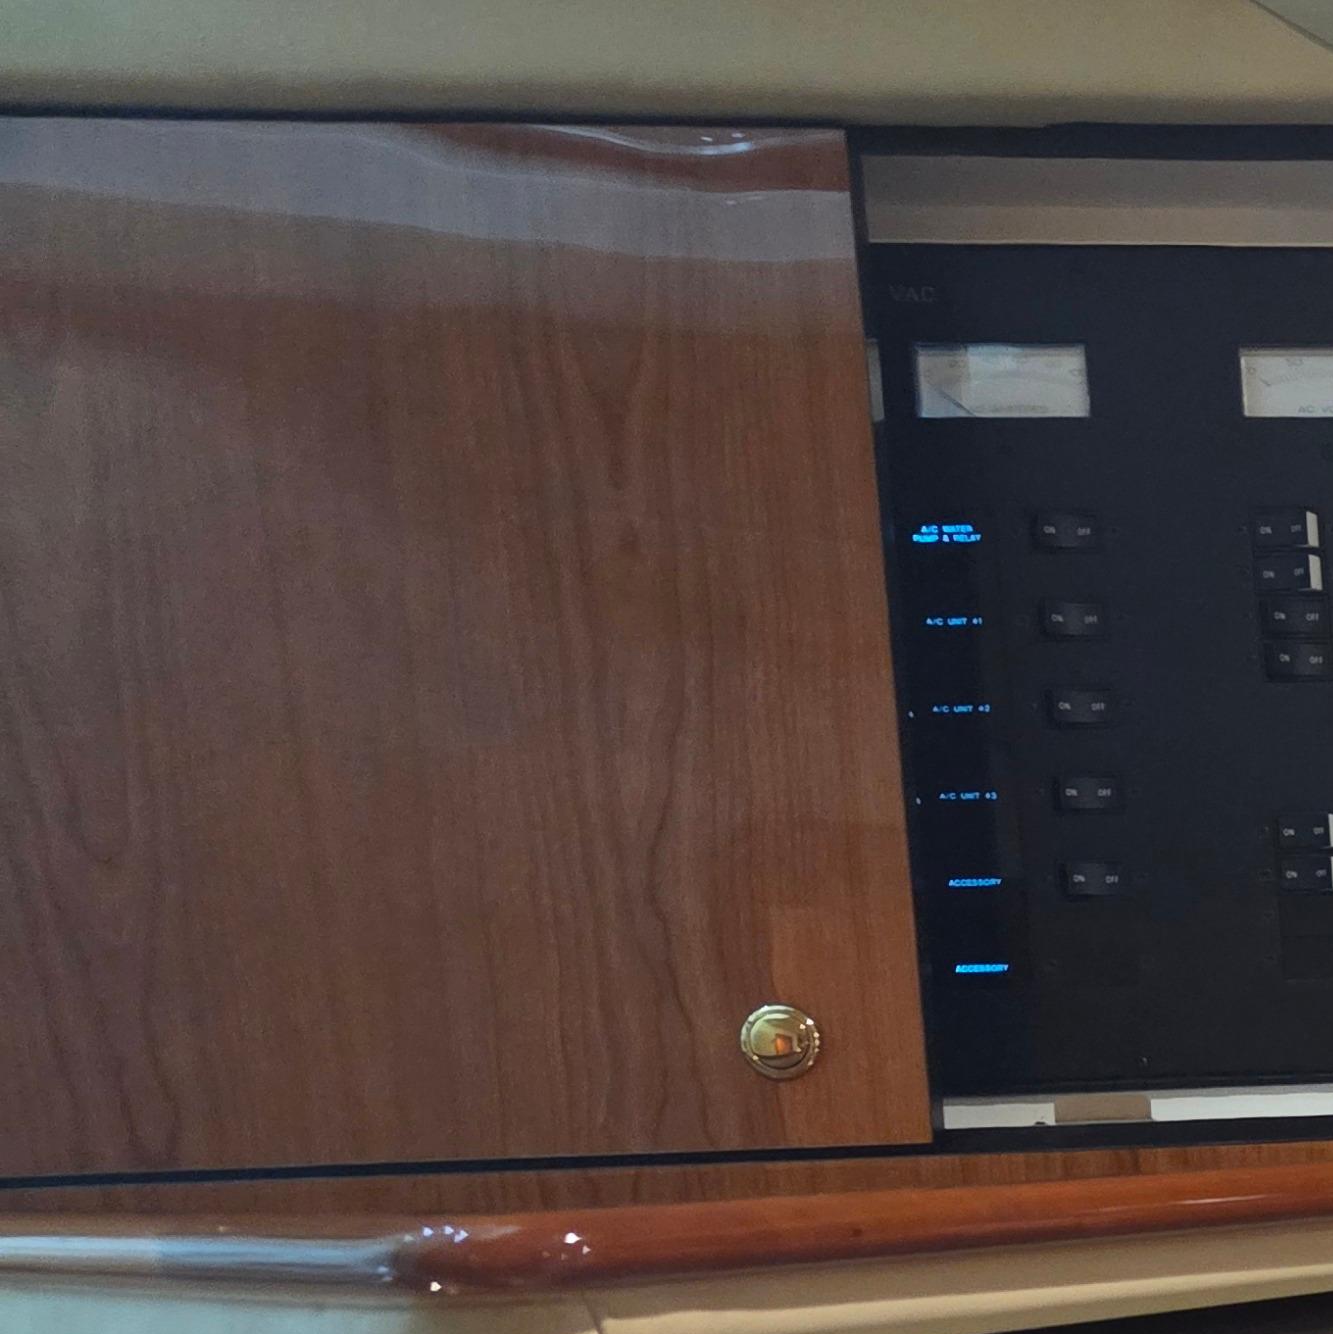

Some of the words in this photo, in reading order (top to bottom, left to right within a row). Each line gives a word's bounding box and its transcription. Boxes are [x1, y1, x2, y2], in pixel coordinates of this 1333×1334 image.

[947, 617, 968, 626] UNIT
[953, 704, 974, 713] UNIT
[939, 791, 957, 800] A/C
[960, 791, 981, 800] UNIT
[949, 878, 1002, 887] ACCESSORY
[955, 963, 1008, 972] ACCESSORY
